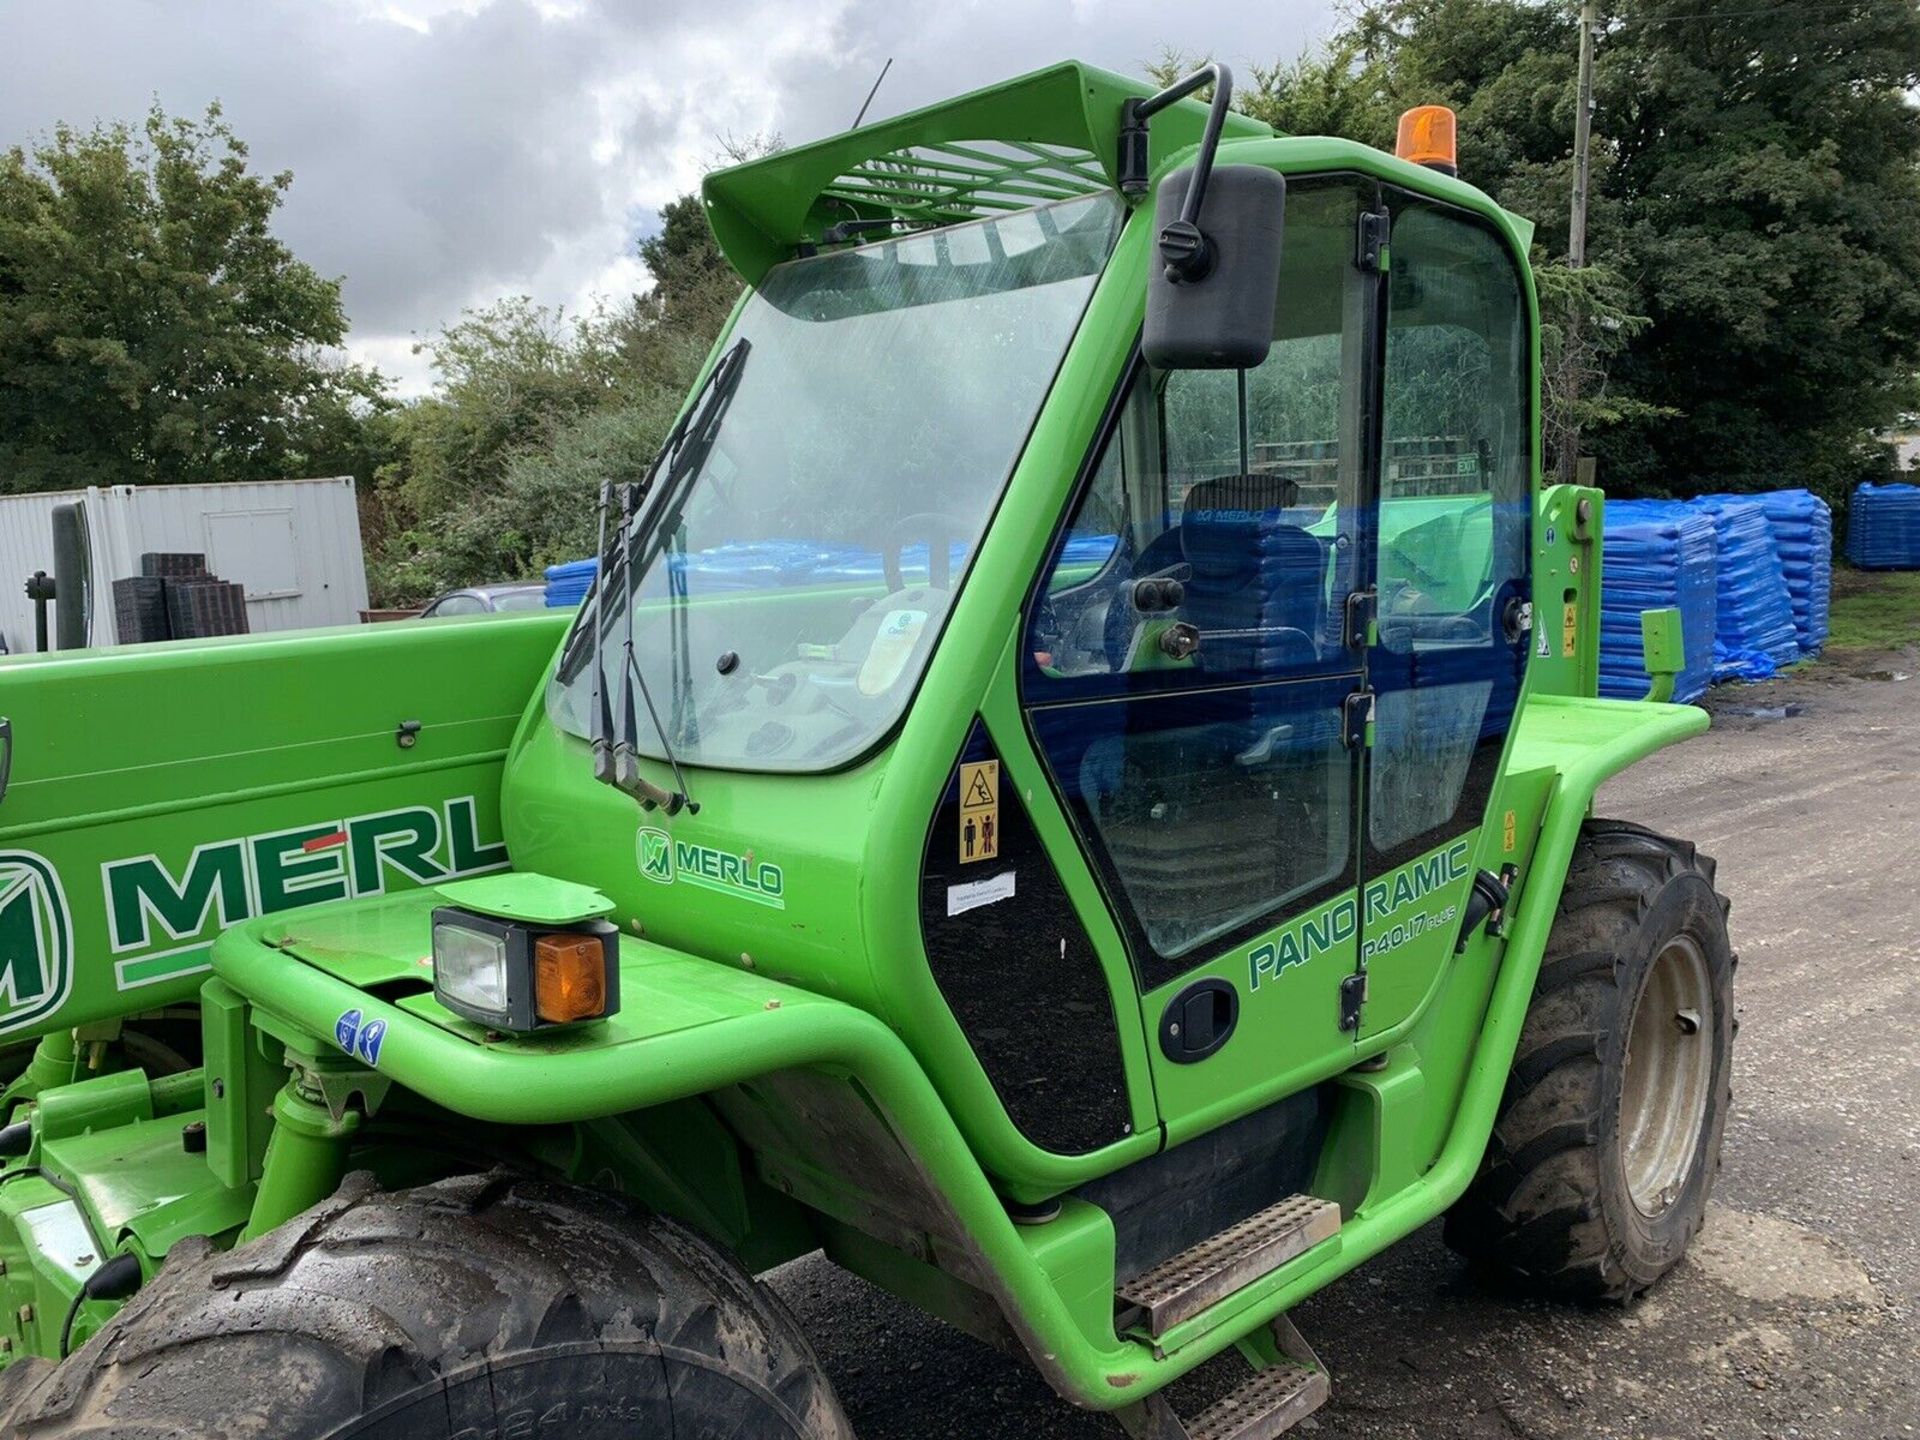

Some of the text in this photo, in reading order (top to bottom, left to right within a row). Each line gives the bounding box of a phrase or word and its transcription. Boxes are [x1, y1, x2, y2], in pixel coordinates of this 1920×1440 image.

[676, 841, 783, 897] MERLO
[1362, 905, 1455, 965] P40.17 PLUS
